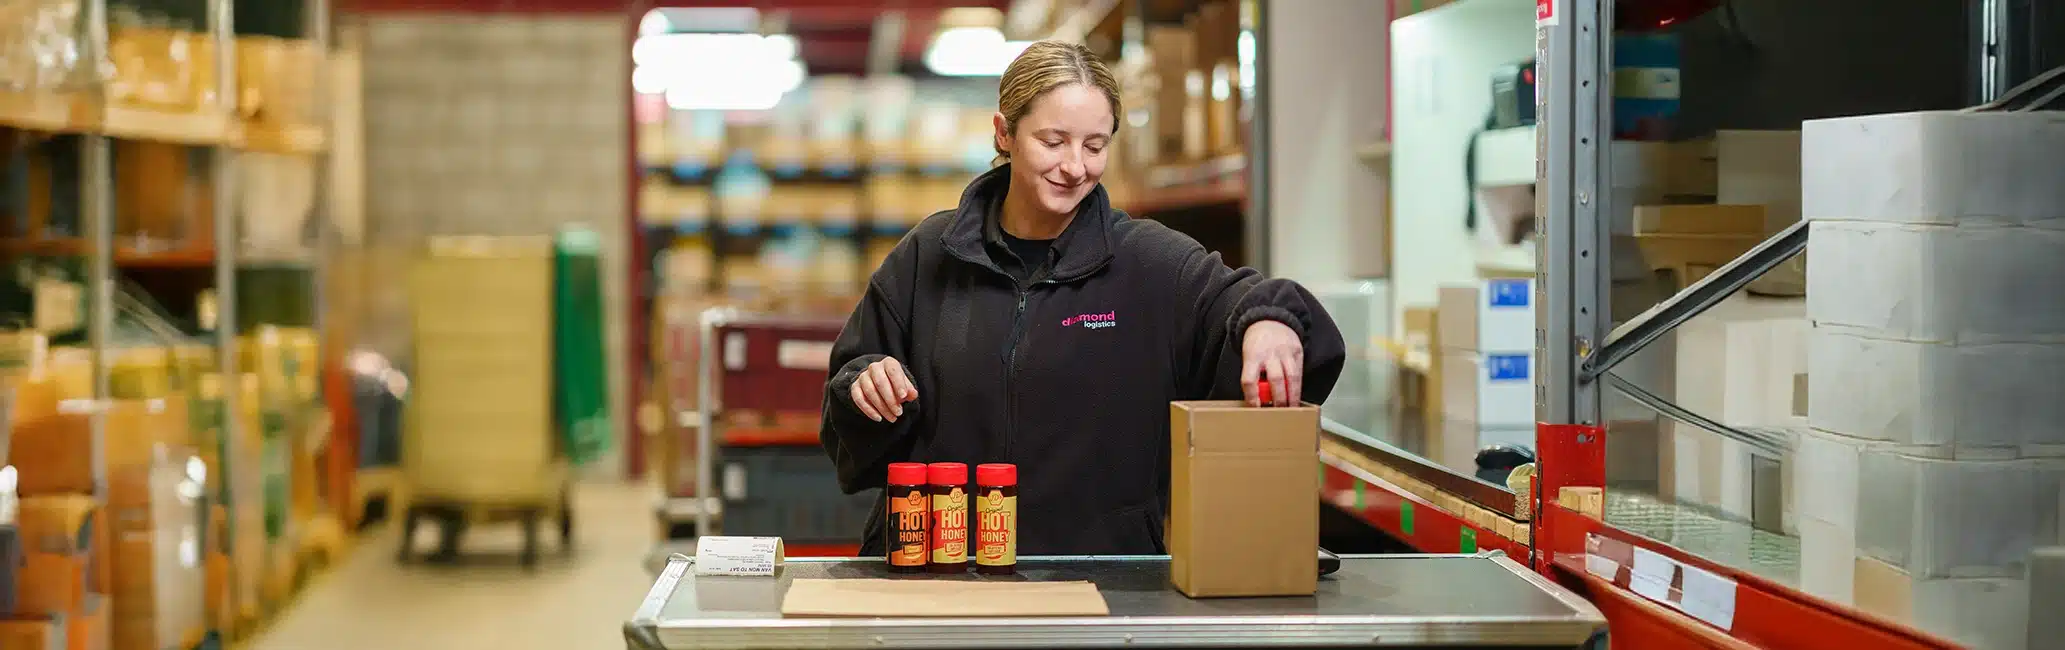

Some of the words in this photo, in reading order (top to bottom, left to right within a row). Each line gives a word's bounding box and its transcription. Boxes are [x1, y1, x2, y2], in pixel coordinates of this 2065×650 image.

[1062, 311, 1115, 326] diamond
[1084, 320, 1116, 329] logistics
[899, 511, 926, 530] HOT
[941, 510, 967, 528] HOT
[981, 512, 1011, 531] HOT
[981, 531, 1011, 543] HONEY
